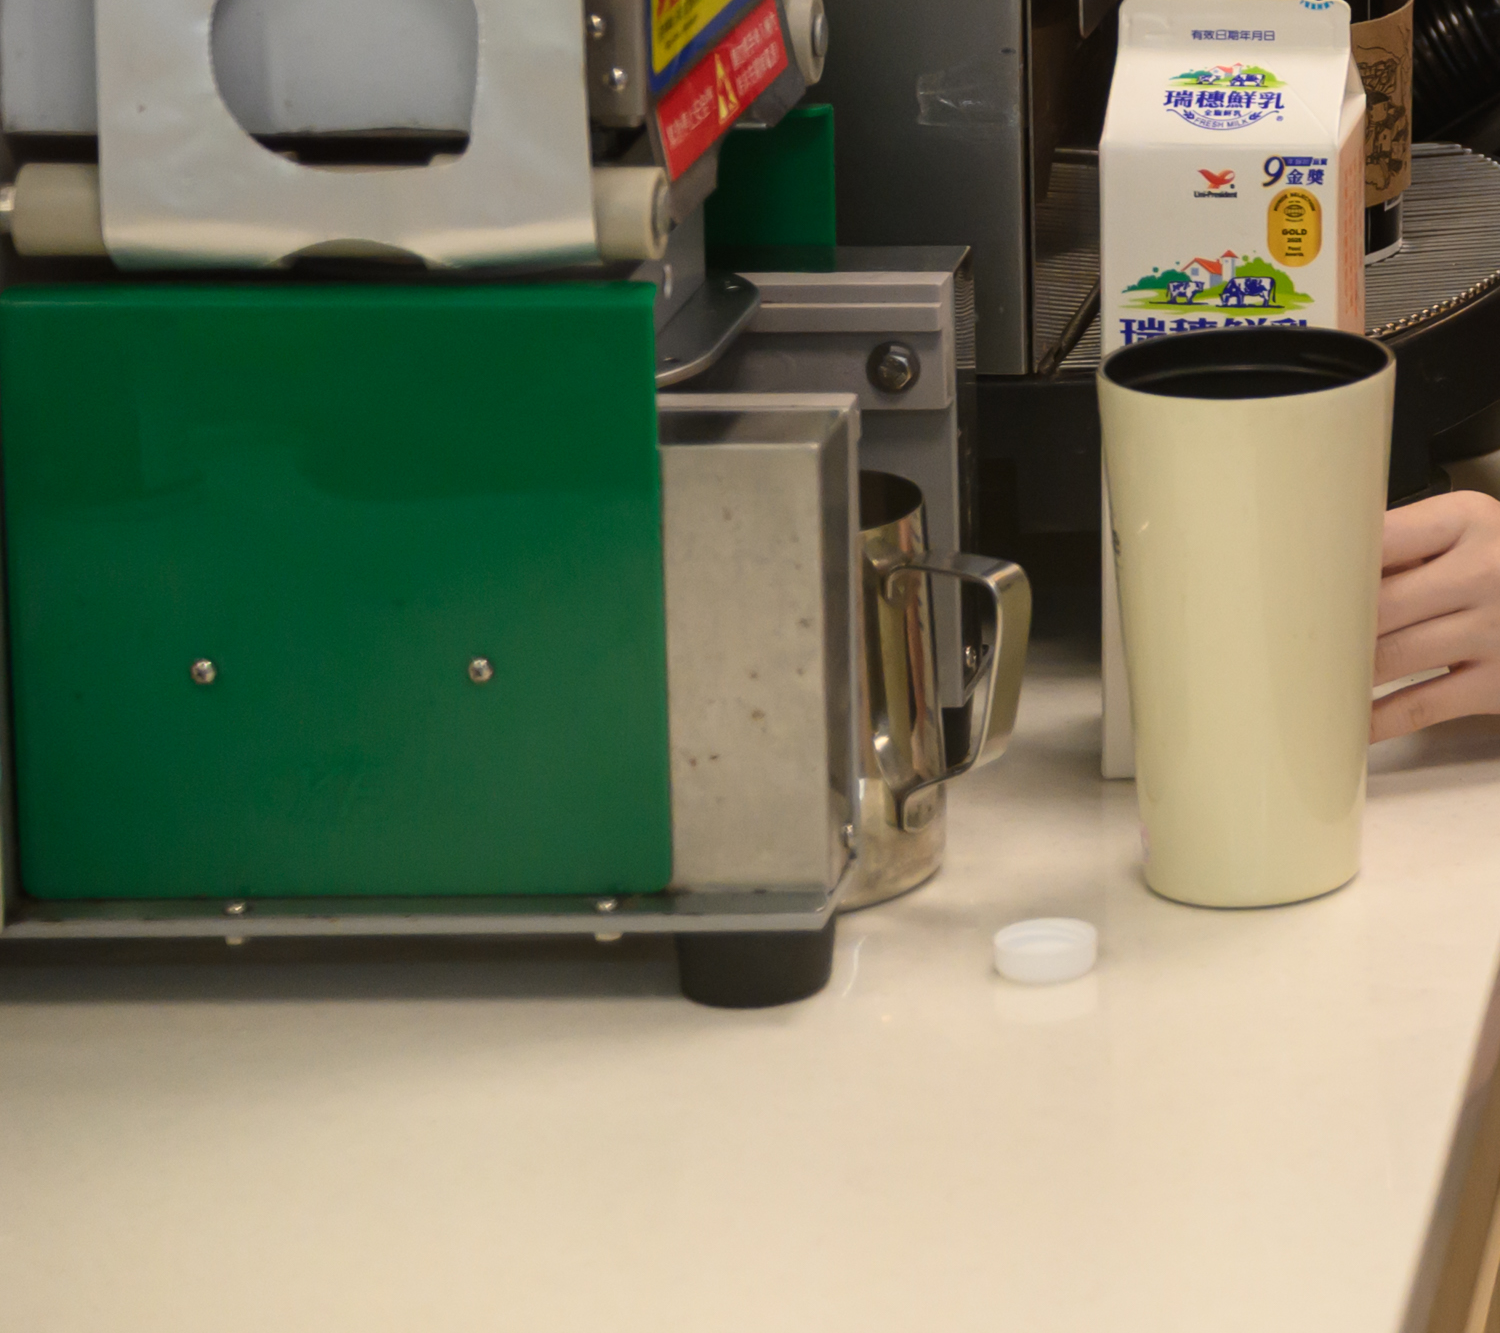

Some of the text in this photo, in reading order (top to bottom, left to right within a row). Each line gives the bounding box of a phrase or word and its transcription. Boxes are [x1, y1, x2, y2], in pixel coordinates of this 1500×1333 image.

[1191, 30, 1275, 42] 有效日期年月日
[1163, 89, 1285, 110] 瑞穗鮮乳
[1194, 117, 1249, 128] FRESH MILK
[1262, 156, 1285, 187] 9
[1285, 168, 1326, 186] 金獎
[1281, 228, 1308, 236] GOLD
